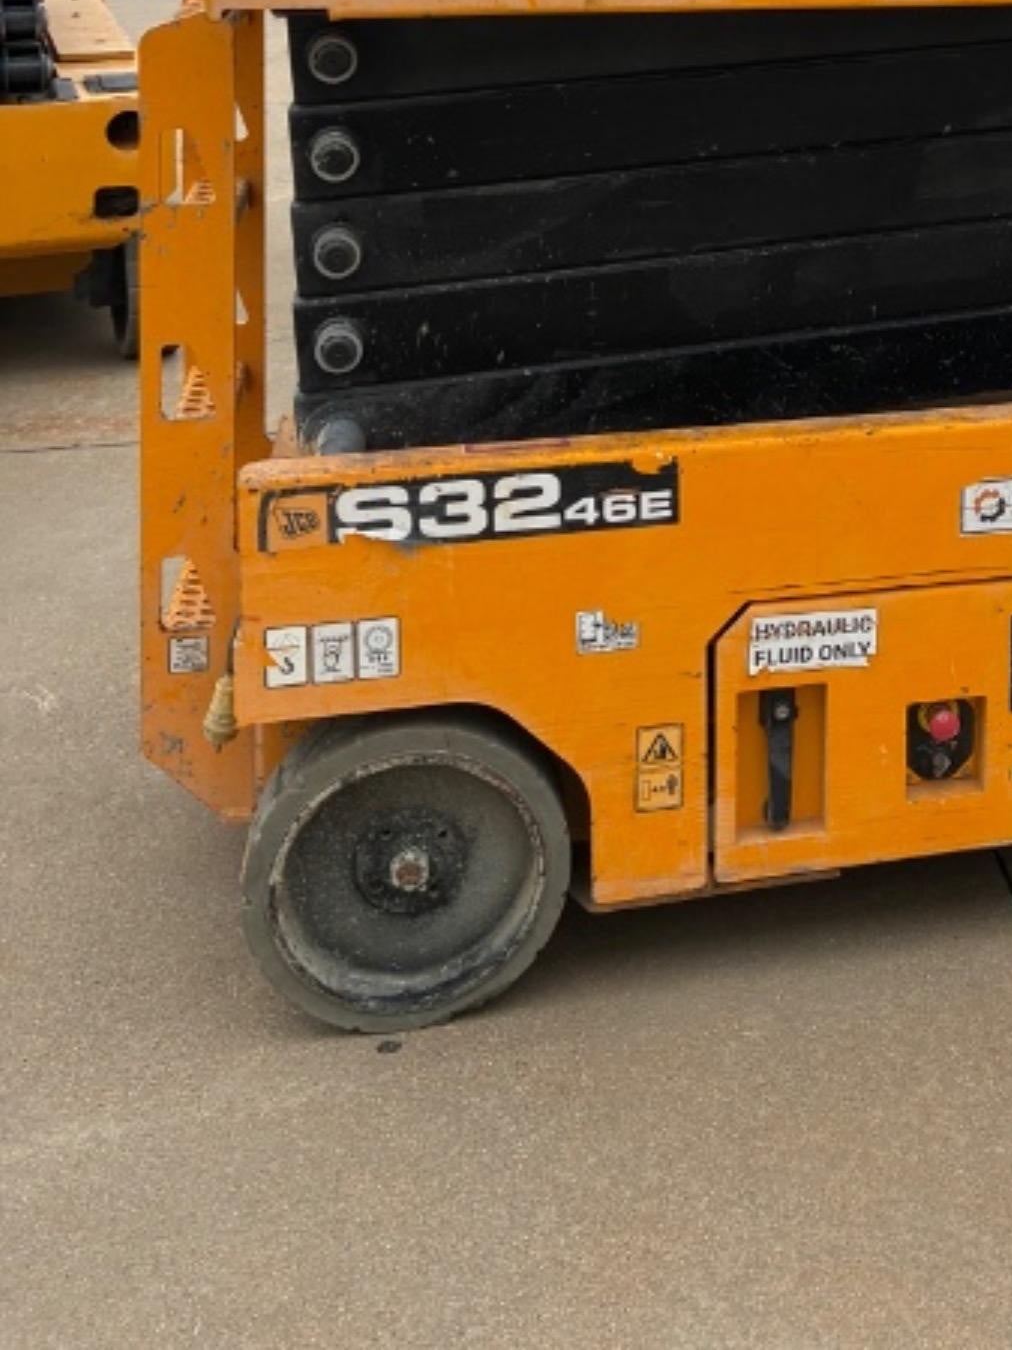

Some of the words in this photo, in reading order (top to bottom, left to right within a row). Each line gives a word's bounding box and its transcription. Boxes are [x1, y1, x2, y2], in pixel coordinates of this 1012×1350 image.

[281, 507, 320, 537] JCB
[754, 644, 814, 667] FLUID
[819, 640, 872, 661] ONLY
